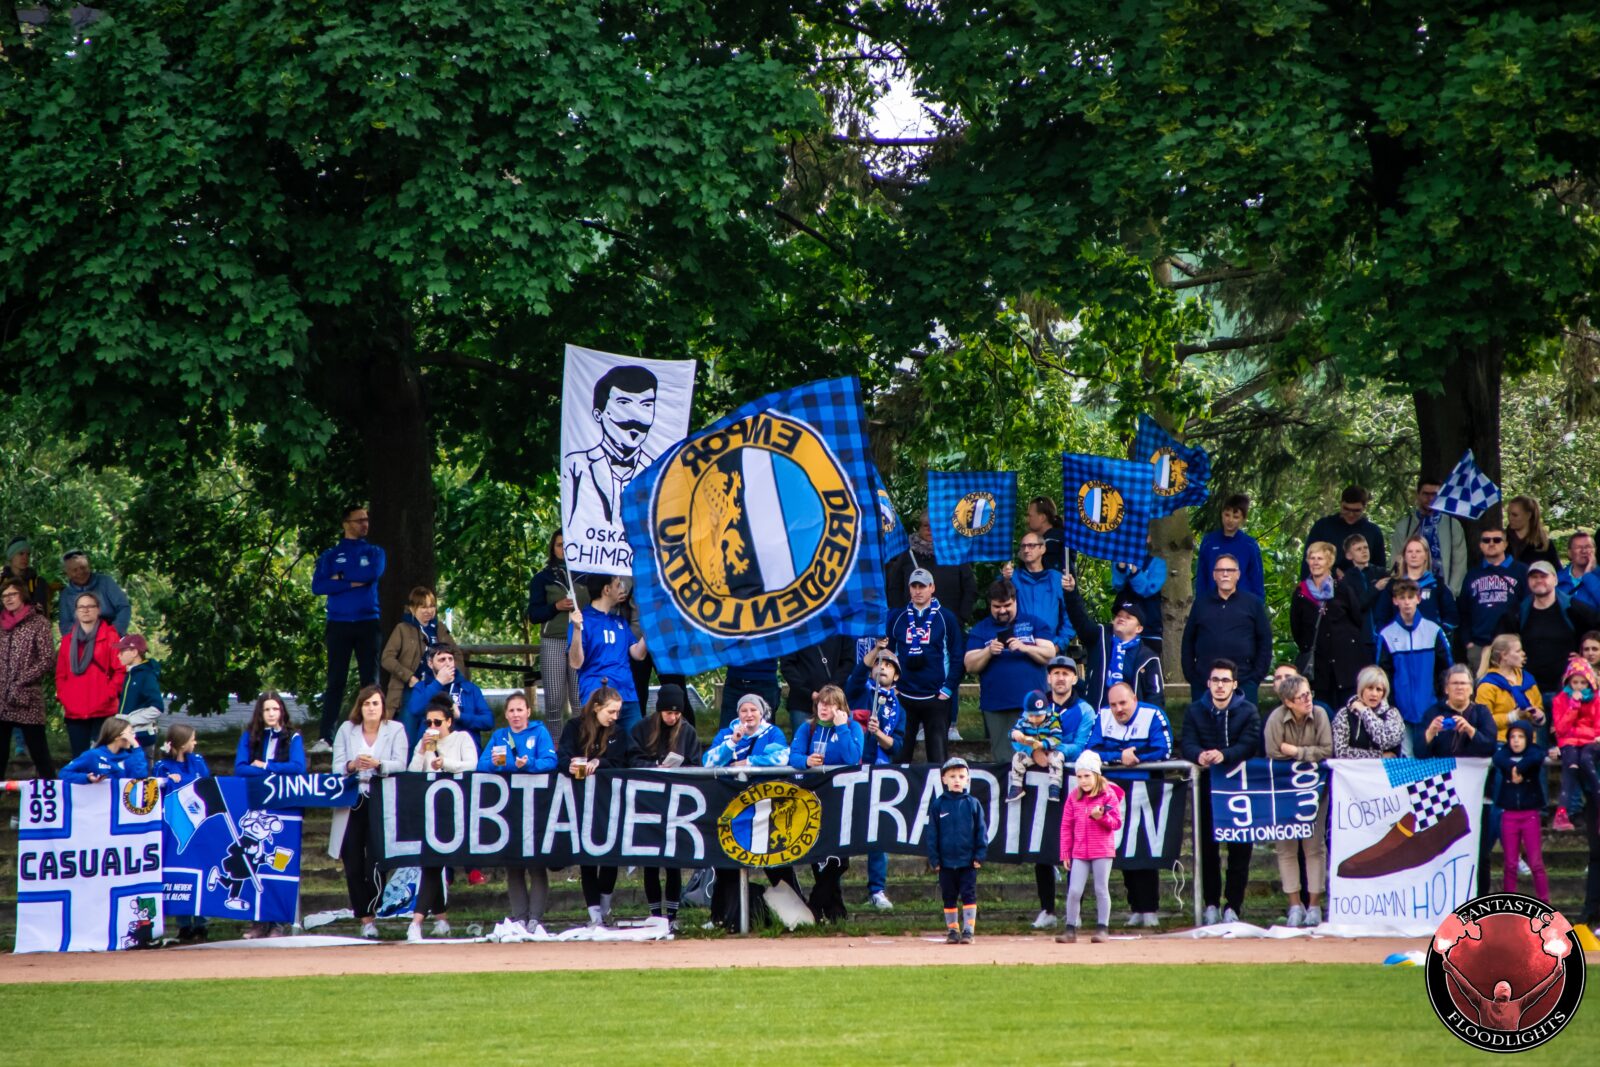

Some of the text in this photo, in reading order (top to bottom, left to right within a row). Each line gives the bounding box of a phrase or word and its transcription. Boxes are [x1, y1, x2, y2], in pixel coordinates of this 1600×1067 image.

[586, 527, 629, 543] OSKA
[1479, 591, 1508, 604] JEANS
[29, 778, 57, 799] 18
[262, 772, 345, 804] SINNLOS
[740, 784, 798, 805] EMPOR
[30, 800, 57, 824] 93
[382, 772, 706, 860] LÖBTAUER
[20, 843, 160, 881] CASUALS
[171, 893, 191, 902] ALONE
[1333, 896, 1361, 916] TOO
[1365, 889, 1406, 917] DAMN
